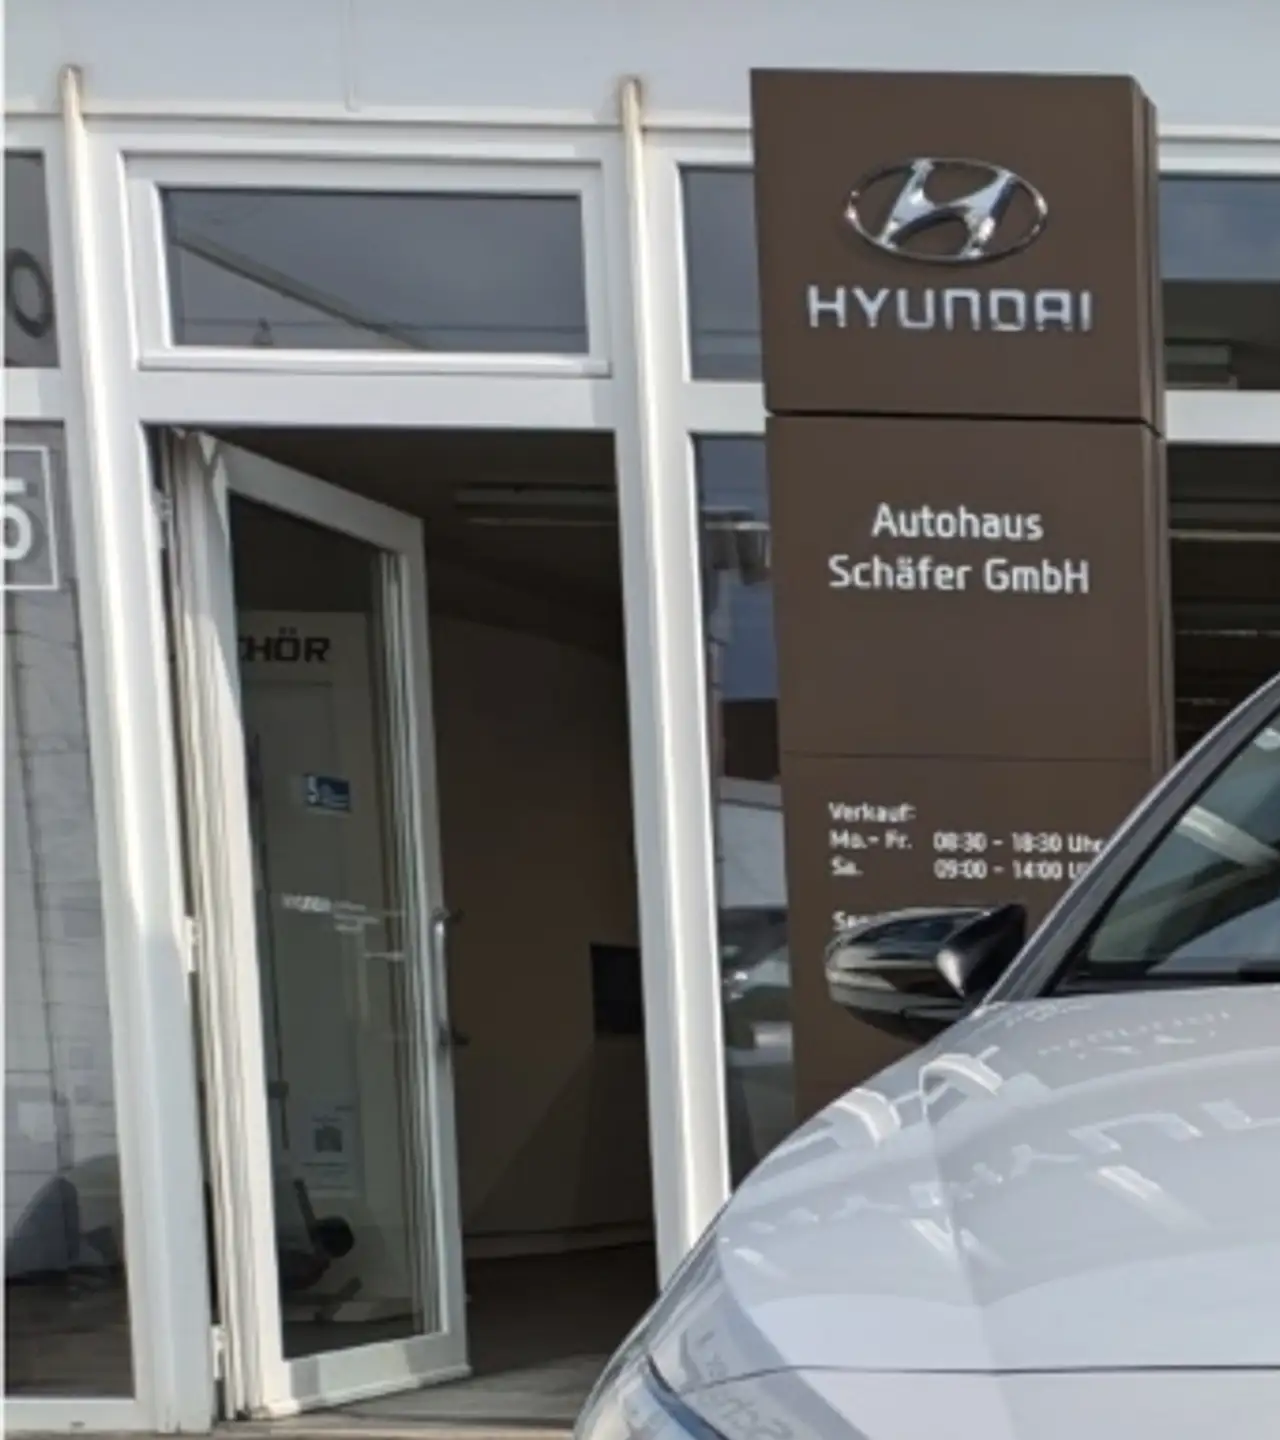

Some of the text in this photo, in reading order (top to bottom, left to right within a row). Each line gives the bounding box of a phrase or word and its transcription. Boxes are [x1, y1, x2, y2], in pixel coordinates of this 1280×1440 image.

[807, 285, 1092, 332] HYUNDAI
[871, 502, 1044, 541] Autohaus
[828, 554, 1090, 594] Schäfer GmbH
[238, 626, 331, 664] HÖR
[828, 802, 916, 823] Verkauf:
[933, 831, 987, 853] 08:30
[1012, 832, 1063, 853] 18:30
[934, 859, 987, 880] 09:00
[1013, 860, 1063, 880] 14:00
